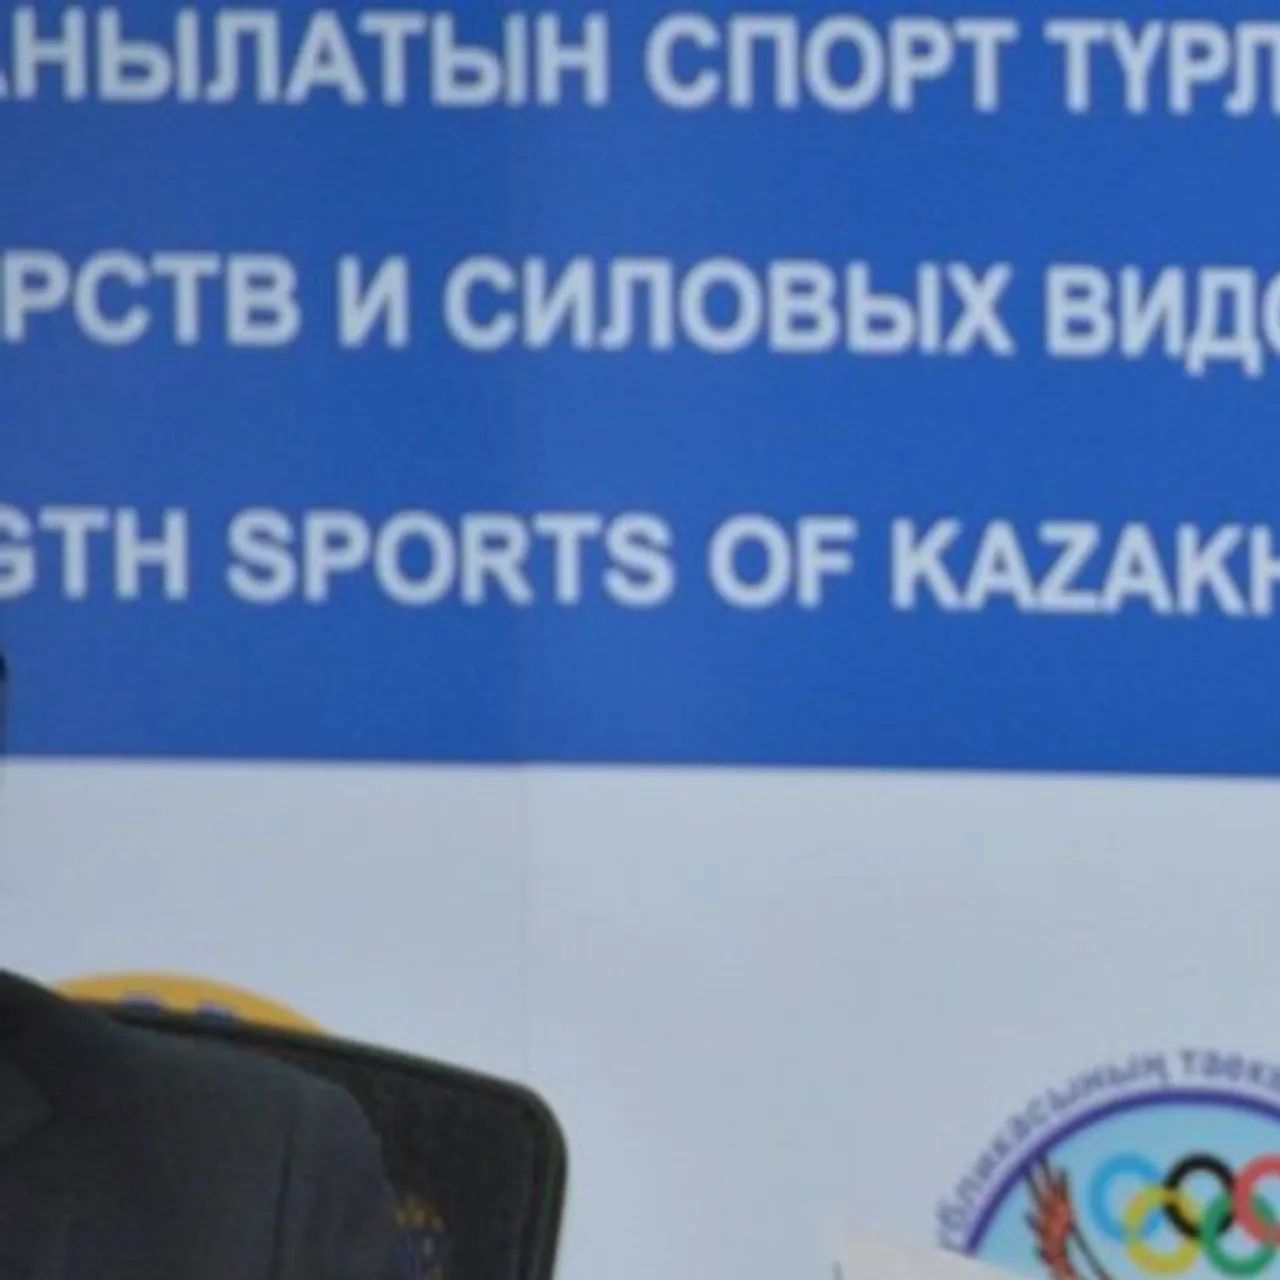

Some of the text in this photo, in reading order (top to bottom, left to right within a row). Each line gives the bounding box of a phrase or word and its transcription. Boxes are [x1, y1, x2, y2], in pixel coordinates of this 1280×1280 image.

[0, 6, 610, 107] НЫЛАТЫН
[645, 14, 1018, 112] СПОРТ
[338, 256, 410, 347] И
[443, 255, 1015, 357] СИЛОВЫХ
[227, 507, 676, 608] SPORTS
[707, 513, 857, 609] OF
